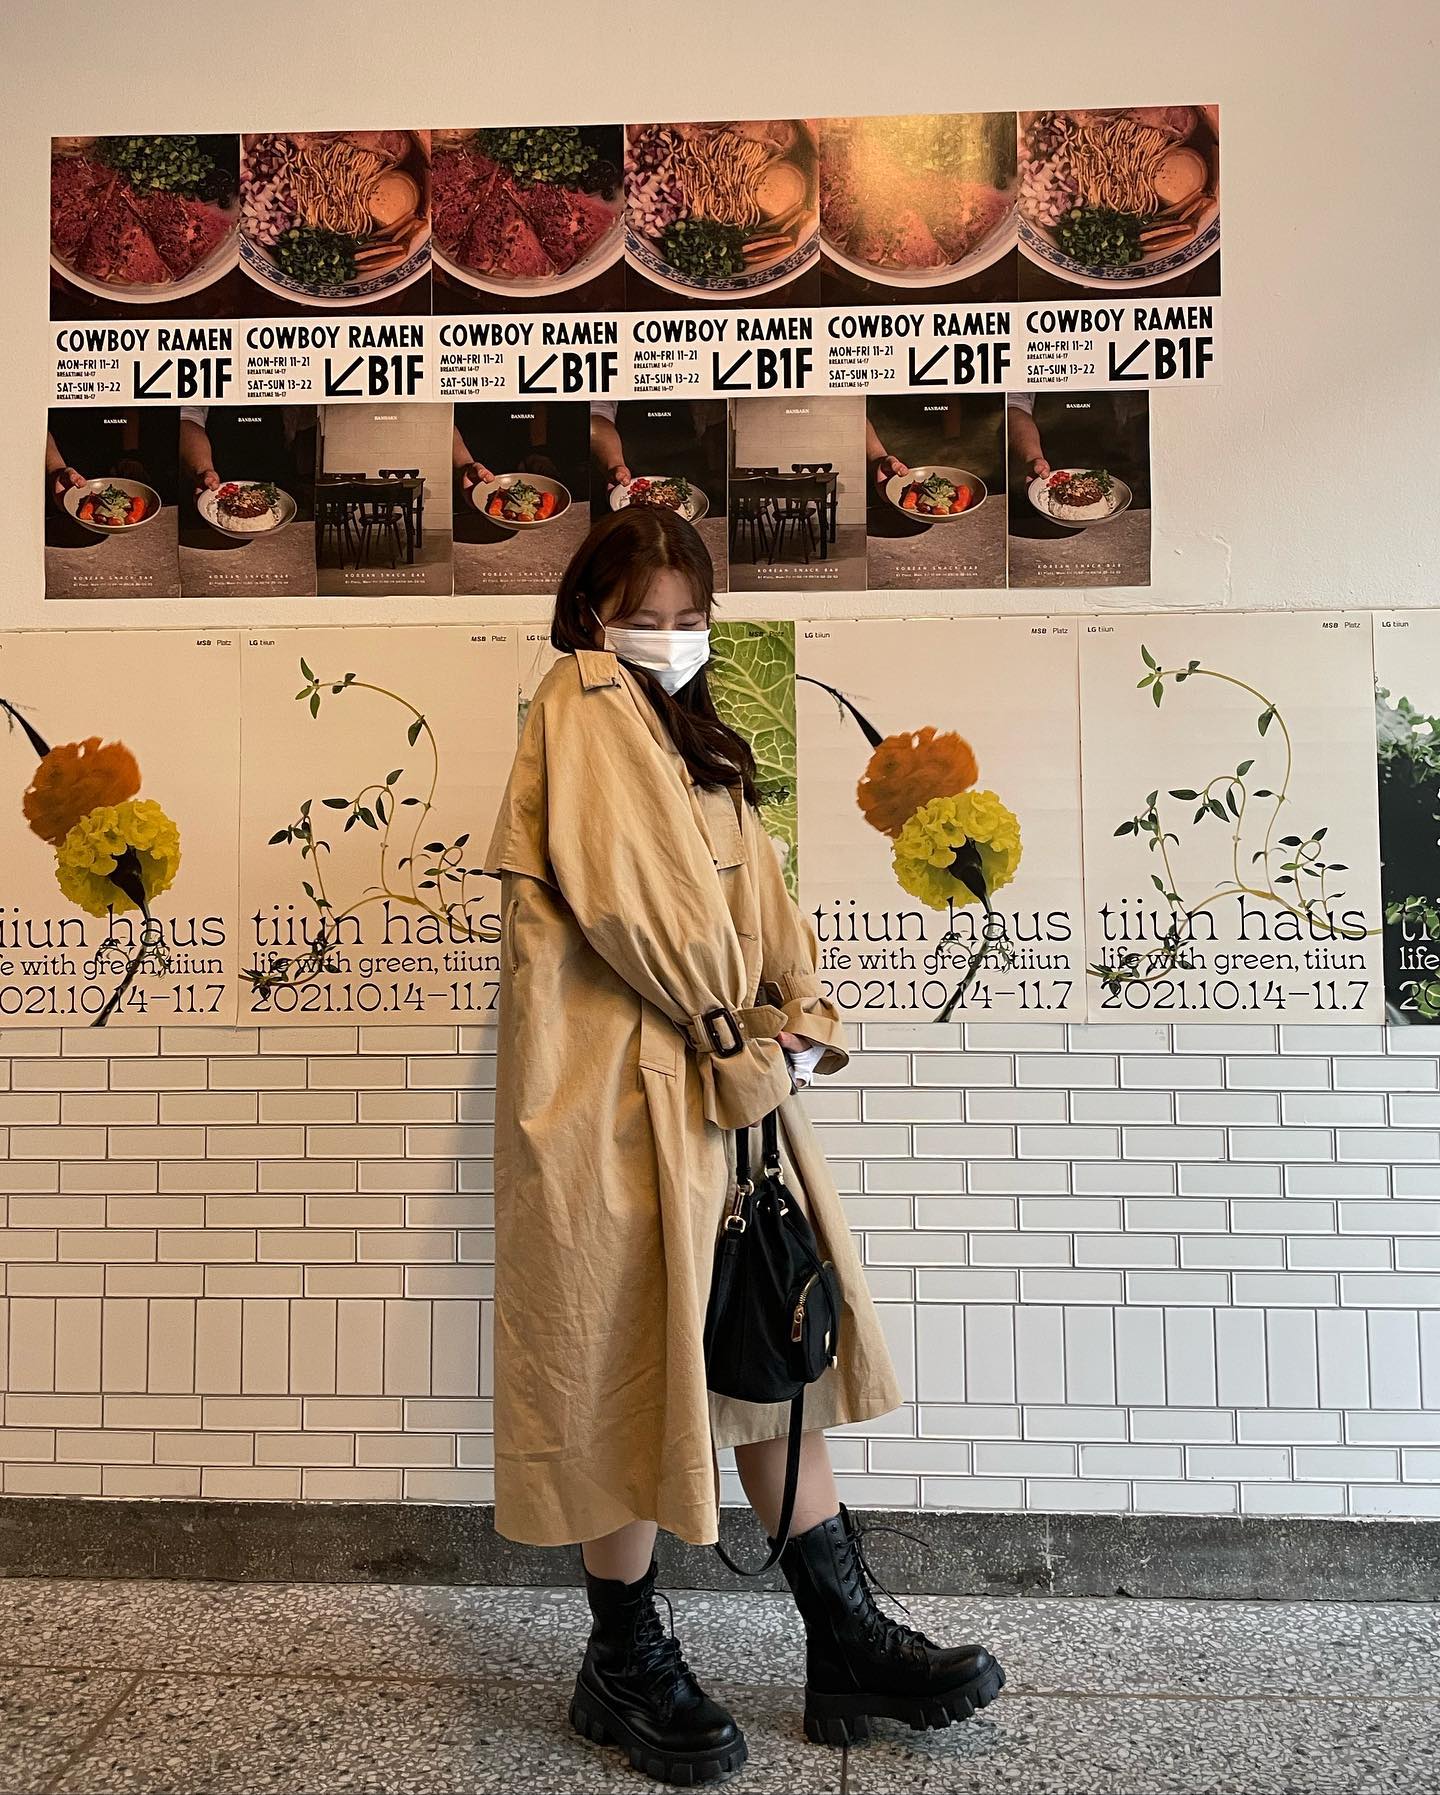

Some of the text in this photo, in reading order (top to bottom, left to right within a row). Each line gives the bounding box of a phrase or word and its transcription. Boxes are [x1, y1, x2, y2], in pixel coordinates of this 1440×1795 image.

[633, 317, 812, 342] COWBOY RAMEN
[828, 313, 1010, 338] COWBOY RAMEN
[1026, 308, 1212, 333] COWBOY RAMEN
[57, 328, 232, 352] COWBOY RAMEN
[247, 325, 423, 349] COWBOY RAMEN
[440, 322, 617, 346] COWBOY RAMEN
[1028, 340, 1093, 351] MON-FRI 11-21
[248, 357, 309, 367] MON-FRI 11-21
[440, 354, 503, 364] MON-FRI 11-21
[634, 350, 697, 360] MON-FRI 11-21
[829, 346, 893, 356] MON-FRI 11-21
[1155, 338, 1213, 379] B1F
[57, 359, 119, 369] MON-FRI 11-21
[369, 355, 423, 395] B1F
[563, 352, 618, 393] B1F
[757, 348, 812, 389] B1F
[829, 369, 895, 379] SAT-SUN 13-22
[954, 343, 1010, 384] B1F
[1028, 364, 1095, 374] SAT-SUN 13-22
[57, 382, 120, 392] SAT-SUN 13-22
[178, 358, 232, 398] B1F
[248, 380, 312, 390] SAT-SUN 13-22
[441, 377, 505, 387] SAT-SUN 13-22
[634, 373, 699, 384] SAT-SUN 13-22
[101, 903, 226, 947] haus
[251, 900, 501, 945] tiiun haus
[811, 896, 1071, 941] tiiun haus
[1098, 895, 1367, 941] tiiun haus
[20, 953, 76, 976] with
[168, 953, 224, 975] tiiun
[359, 956, 438, 978] green,
[443, 950, 500, 971] tiiun
[820, 947, 851, 969] ife
[858, 947, 917, 969] with
[1010, 949, 1071, 970] tiiun
[1214, 953, 1298, 975] green,
[1304, 948, 1366, 969] tiiun
[1399, 946, 1440, 970] life
